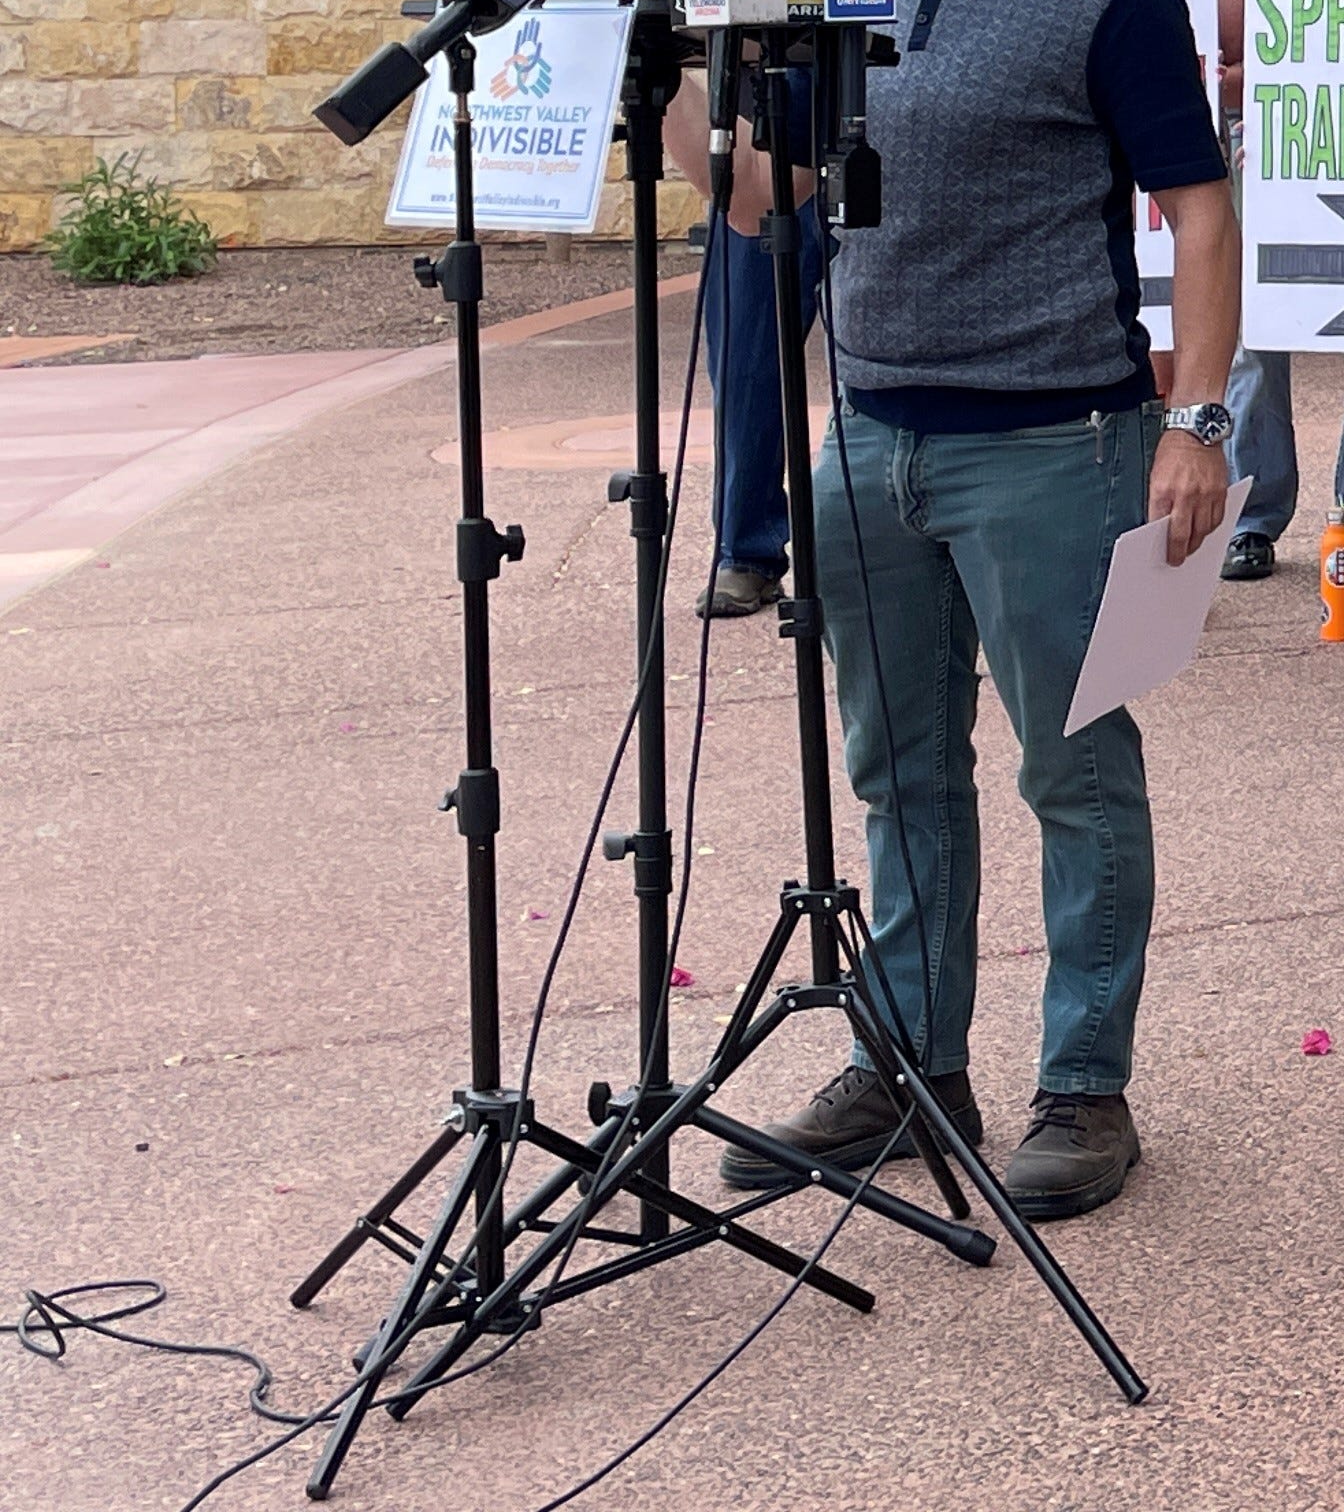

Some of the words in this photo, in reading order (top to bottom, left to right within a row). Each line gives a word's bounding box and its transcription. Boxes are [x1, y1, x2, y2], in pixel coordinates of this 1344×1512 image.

[438, 104, 532, 122] NOTHWEST
[536, 106, 592, 123] VALLEY
[430, 125, 587, 156] INIVISIBLE
